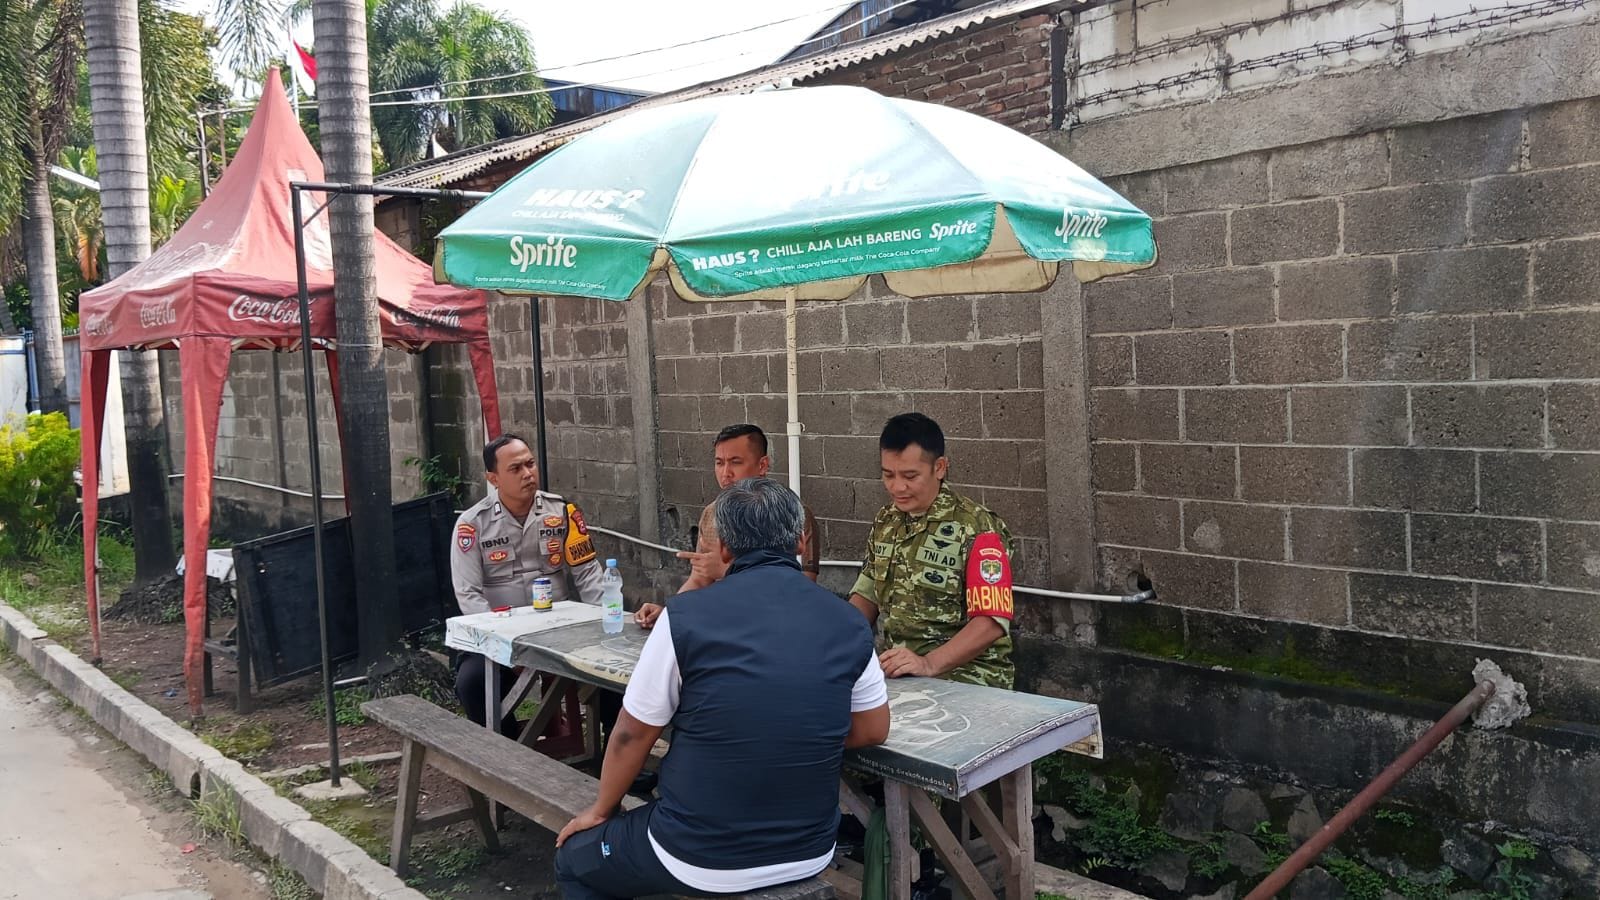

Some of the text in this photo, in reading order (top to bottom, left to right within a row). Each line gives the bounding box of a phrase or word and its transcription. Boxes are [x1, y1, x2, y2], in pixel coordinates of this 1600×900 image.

[1054, 208, 1108, 243] Sprite
[766, 243, 805, 259] CHILL
[807, 239, 833, 253] AJA
[836, 234, 863, 249] LAH
[866, 228, 922, 245] BARENG
[928, 219, 978, 242] Sprite
[510, 235, 577, 273] Sprite
[482, 536, 509, 549] IBNU
[539, 527, 566, 538] POLRI
[923, 549, 956, 567] TNI AD
